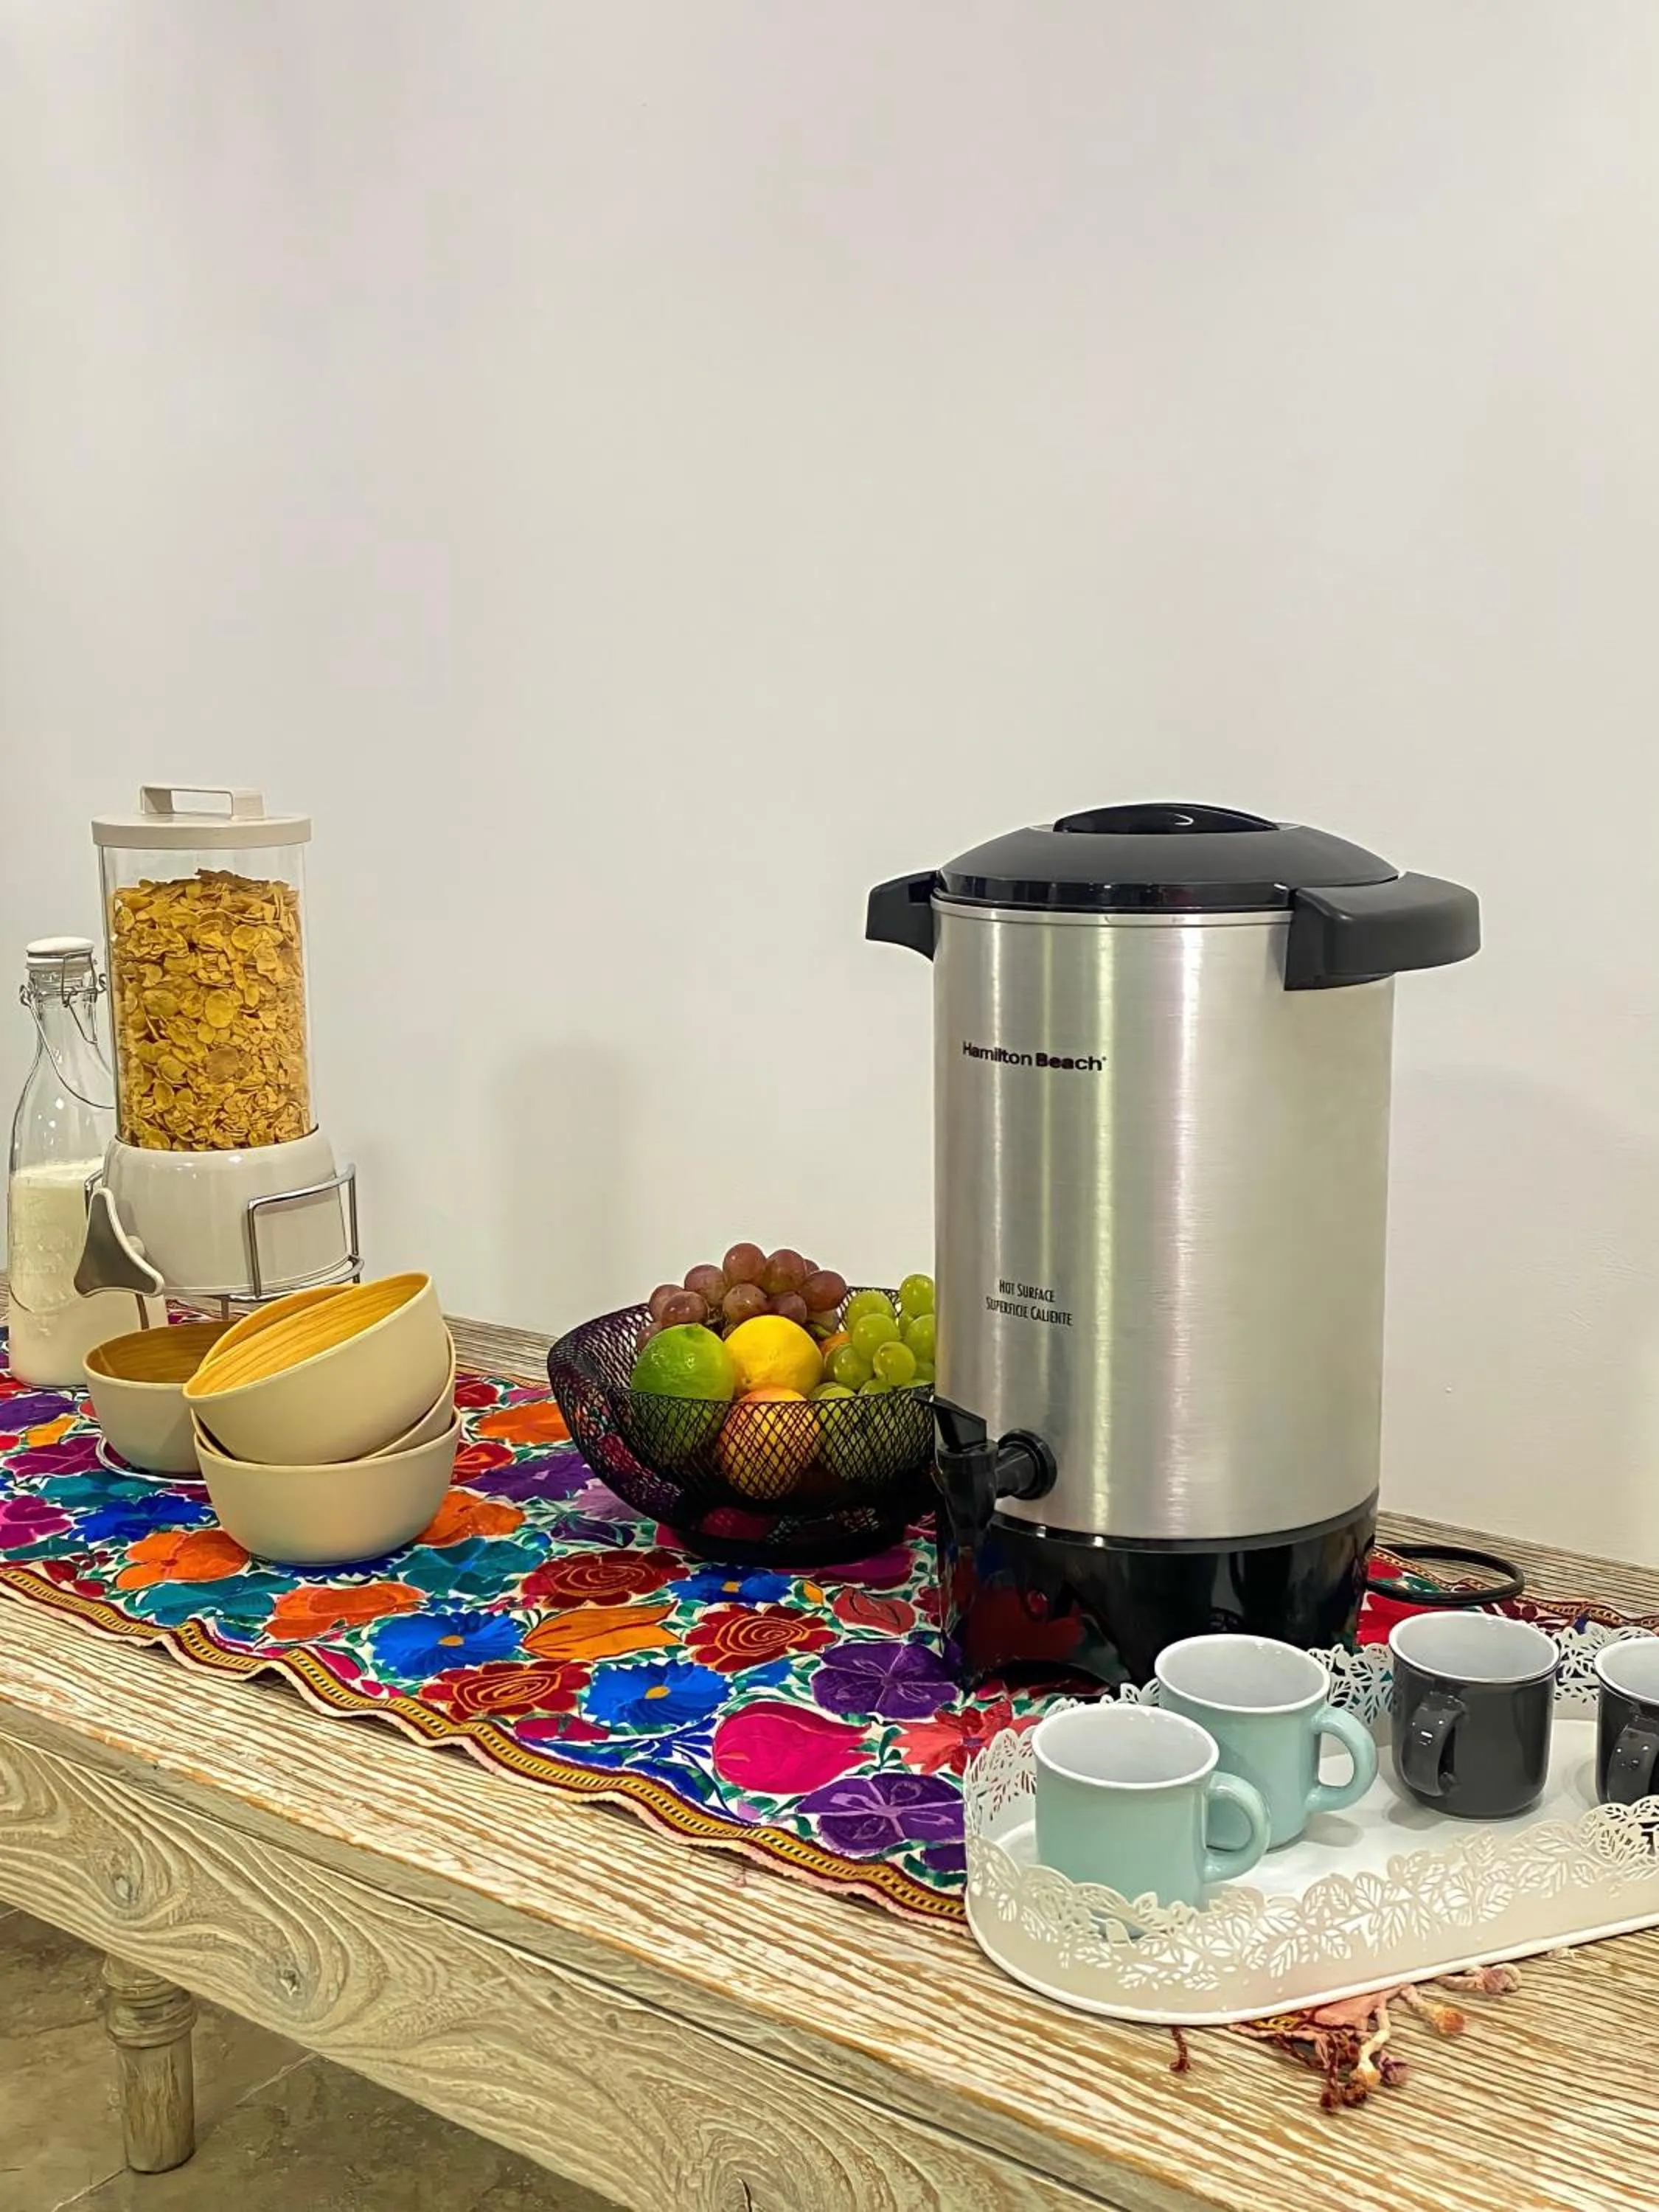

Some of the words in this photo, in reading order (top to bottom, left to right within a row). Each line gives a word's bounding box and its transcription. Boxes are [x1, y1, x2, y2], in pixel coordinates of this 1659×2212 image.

[962, 1040, 1032, 1066] Hamilton
[1035, 1052, 1103, 1071] Beach
[999, 1279, 1015, 1295] HOT
[1017, 1283, 1055, 1303] SURFACE
[986, 1296, 1029, 1318] SUPERFICIE
[1030, 1306, 1073, 1326] CALIENTE
